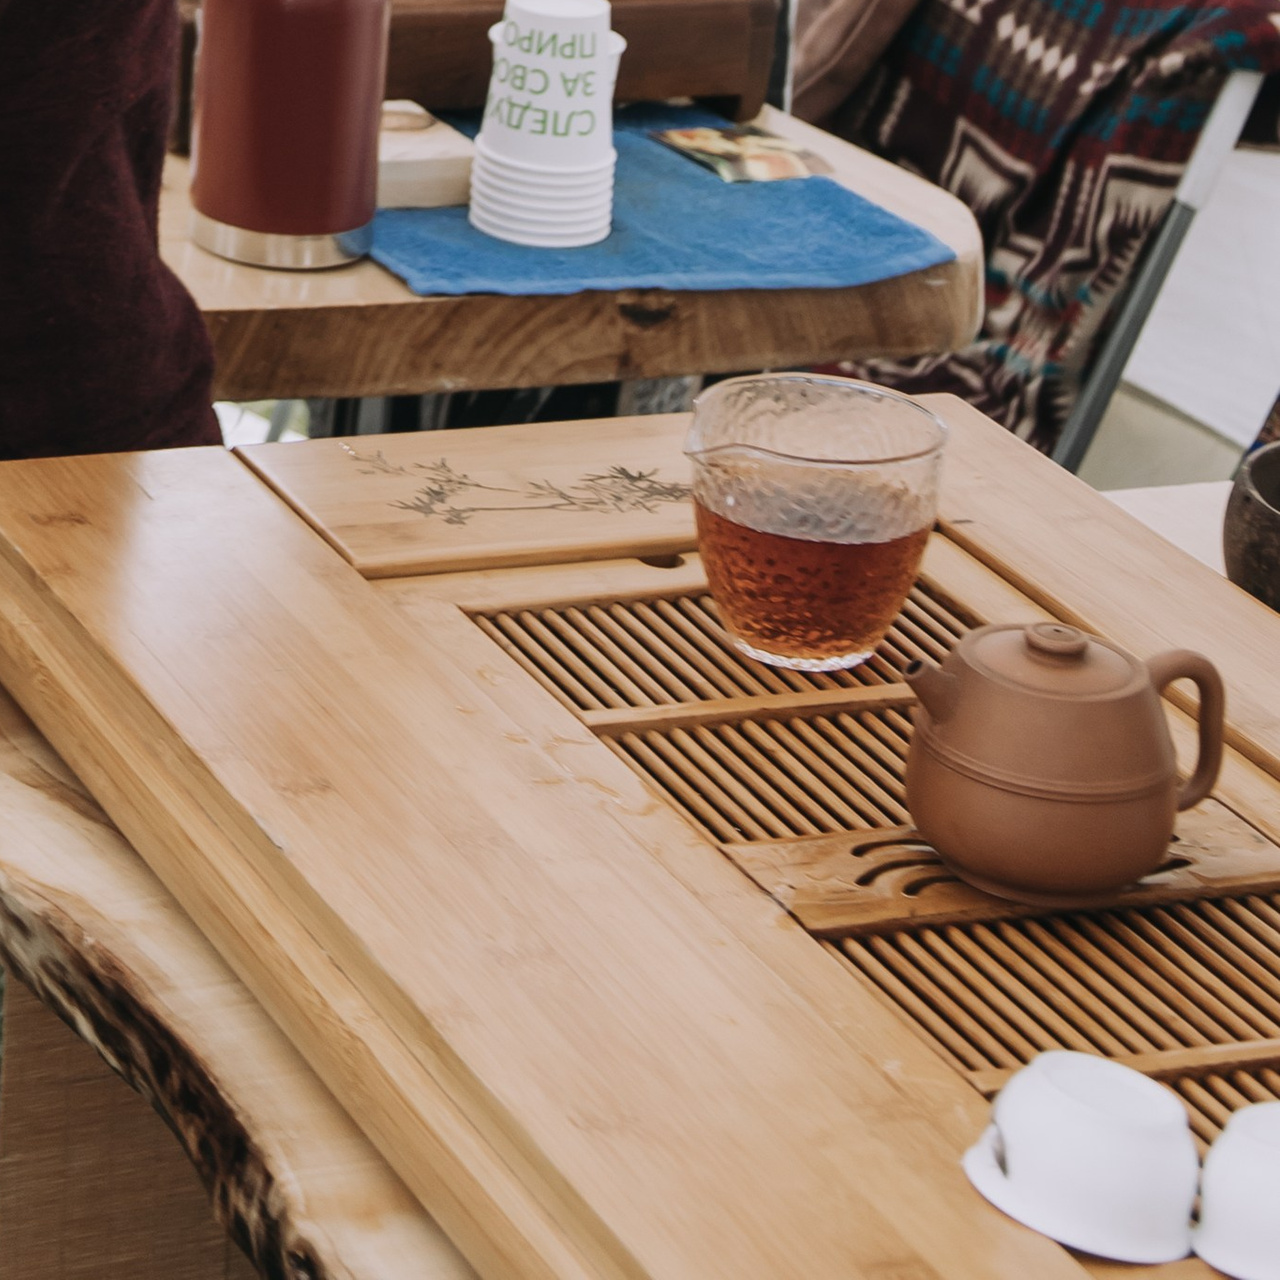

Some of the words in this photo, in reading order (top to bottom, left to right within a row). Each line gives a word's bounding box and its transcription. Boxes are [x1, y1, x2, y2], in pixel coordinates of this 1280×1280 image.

[503, 15, 596, 59] ПРИРО
[493, 57, 549, 94] СВО
[560, 70, 596, 97] ЗА
[486, 94, 595, 137] СЛЕДУ
